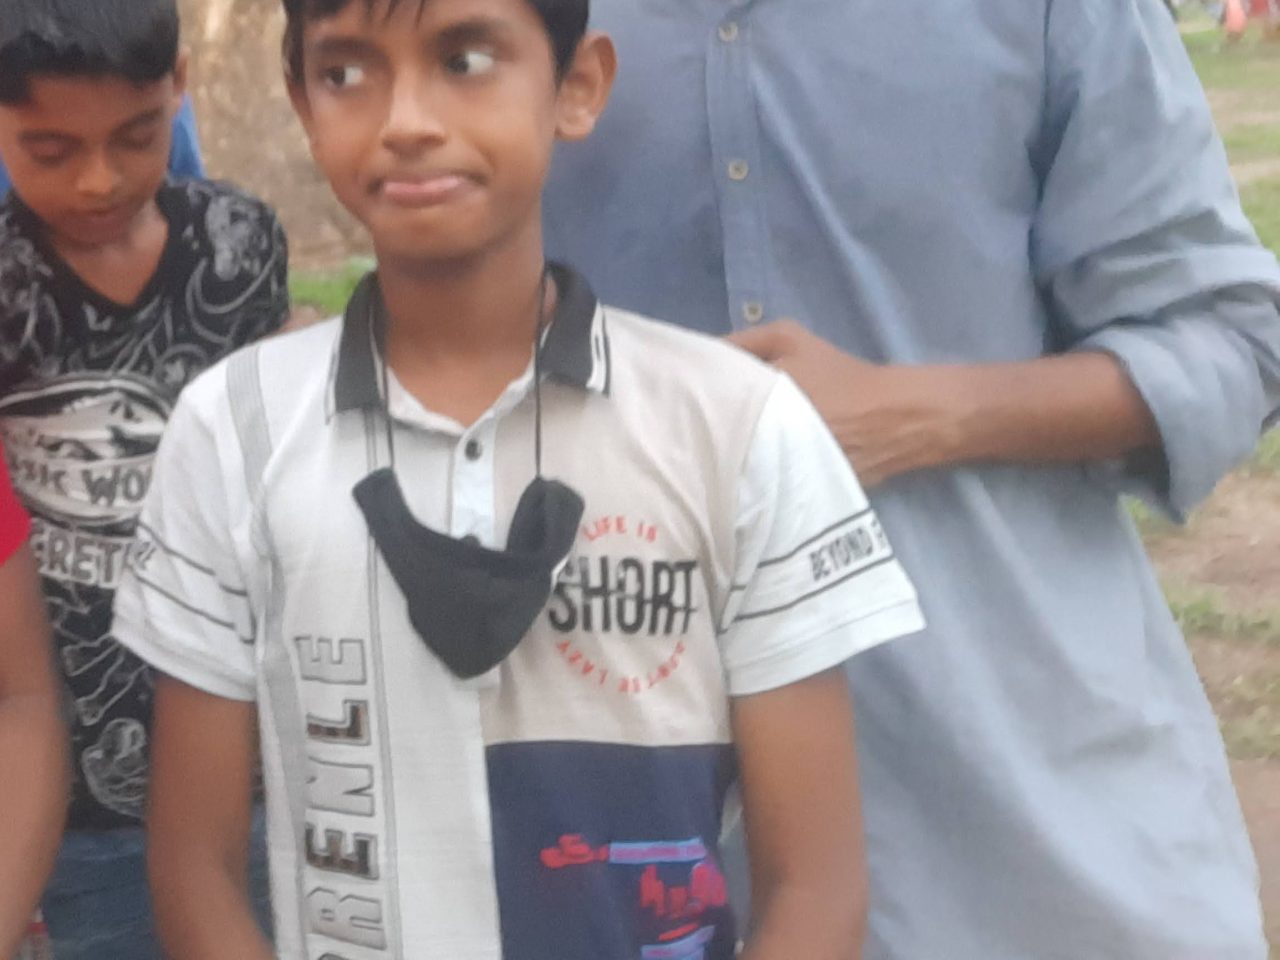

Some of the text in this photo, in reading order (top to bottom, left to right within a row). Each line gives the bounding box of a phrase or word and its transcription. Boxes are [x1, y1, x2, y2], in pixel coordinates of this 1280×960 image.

[582, 515, 658, 544] LIFE IS
[809, 526, 874, 582] BEYOND
[548, 555, 699, 636] SHORT
[293, 635, 388, 959] RENLE
